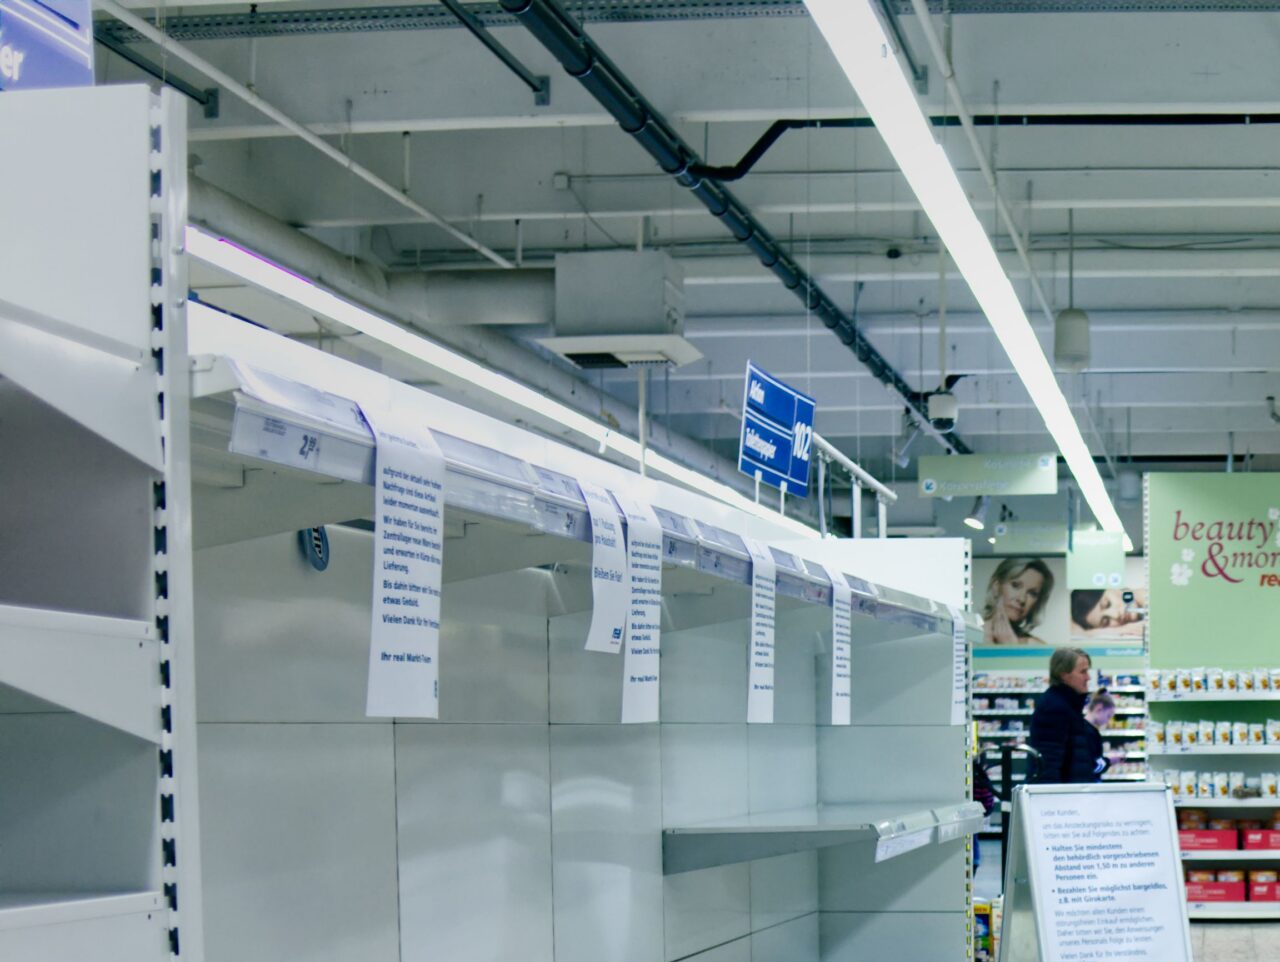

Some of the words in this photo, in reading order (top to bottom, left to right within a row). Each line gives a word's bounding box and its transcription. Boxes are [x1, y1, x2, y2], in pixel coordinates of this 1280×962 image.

[793, 421, 812, 461] 102
[1173, 510, 1274, 549] beauty
[1201, 542, 1244, 584] &
[1086, 843, 1123, 851] mindestens
[1066, 853, 1101, 862] behördlich
[1102, 851, 1160, 861] vorgeschriebenen
[1054, 864, 1081, 872] Abstand
[1129, 861, 1155, 869] anderen
[1057, 887, 1086, 895] Bezahlen
[1099, 884, 1131, 893] möglichst
